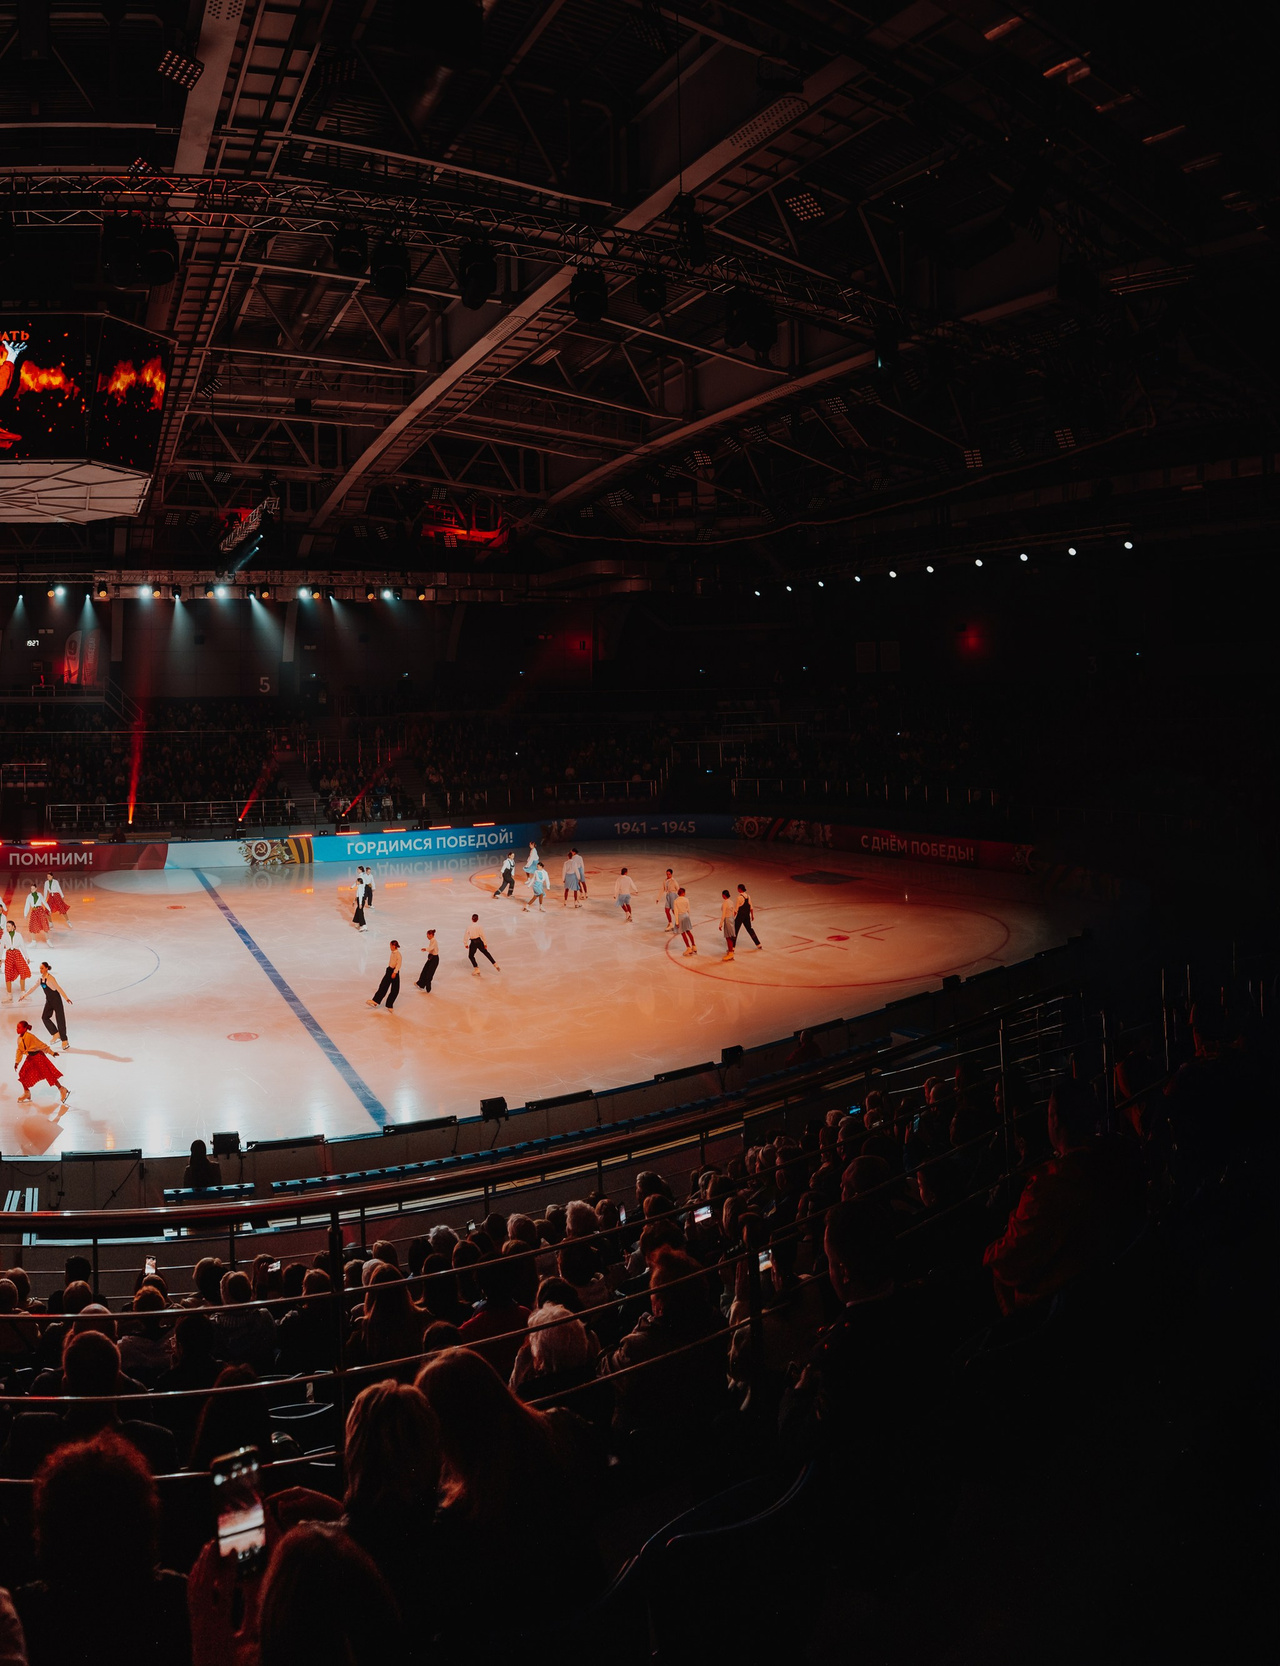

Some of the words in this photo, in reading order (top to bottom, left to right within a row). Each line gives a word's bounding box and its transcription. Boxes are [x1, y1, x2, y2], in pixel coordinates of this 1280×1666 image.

[259, 676, 271, 693] 5
[614, 821, 647, 834] 1941
[661, 820, 697, 834] 1945
[347, 837, 432, 856] ГОРДИМСЯ
[436, 828, 514, 849] ПОБЕДОЙ!
[871, 834, 908, 854] ДНЁМ
[911, 840, 975, 862] ПОБЕДЫ!
[9, 852, 93, 866] ПОМНИМ!
